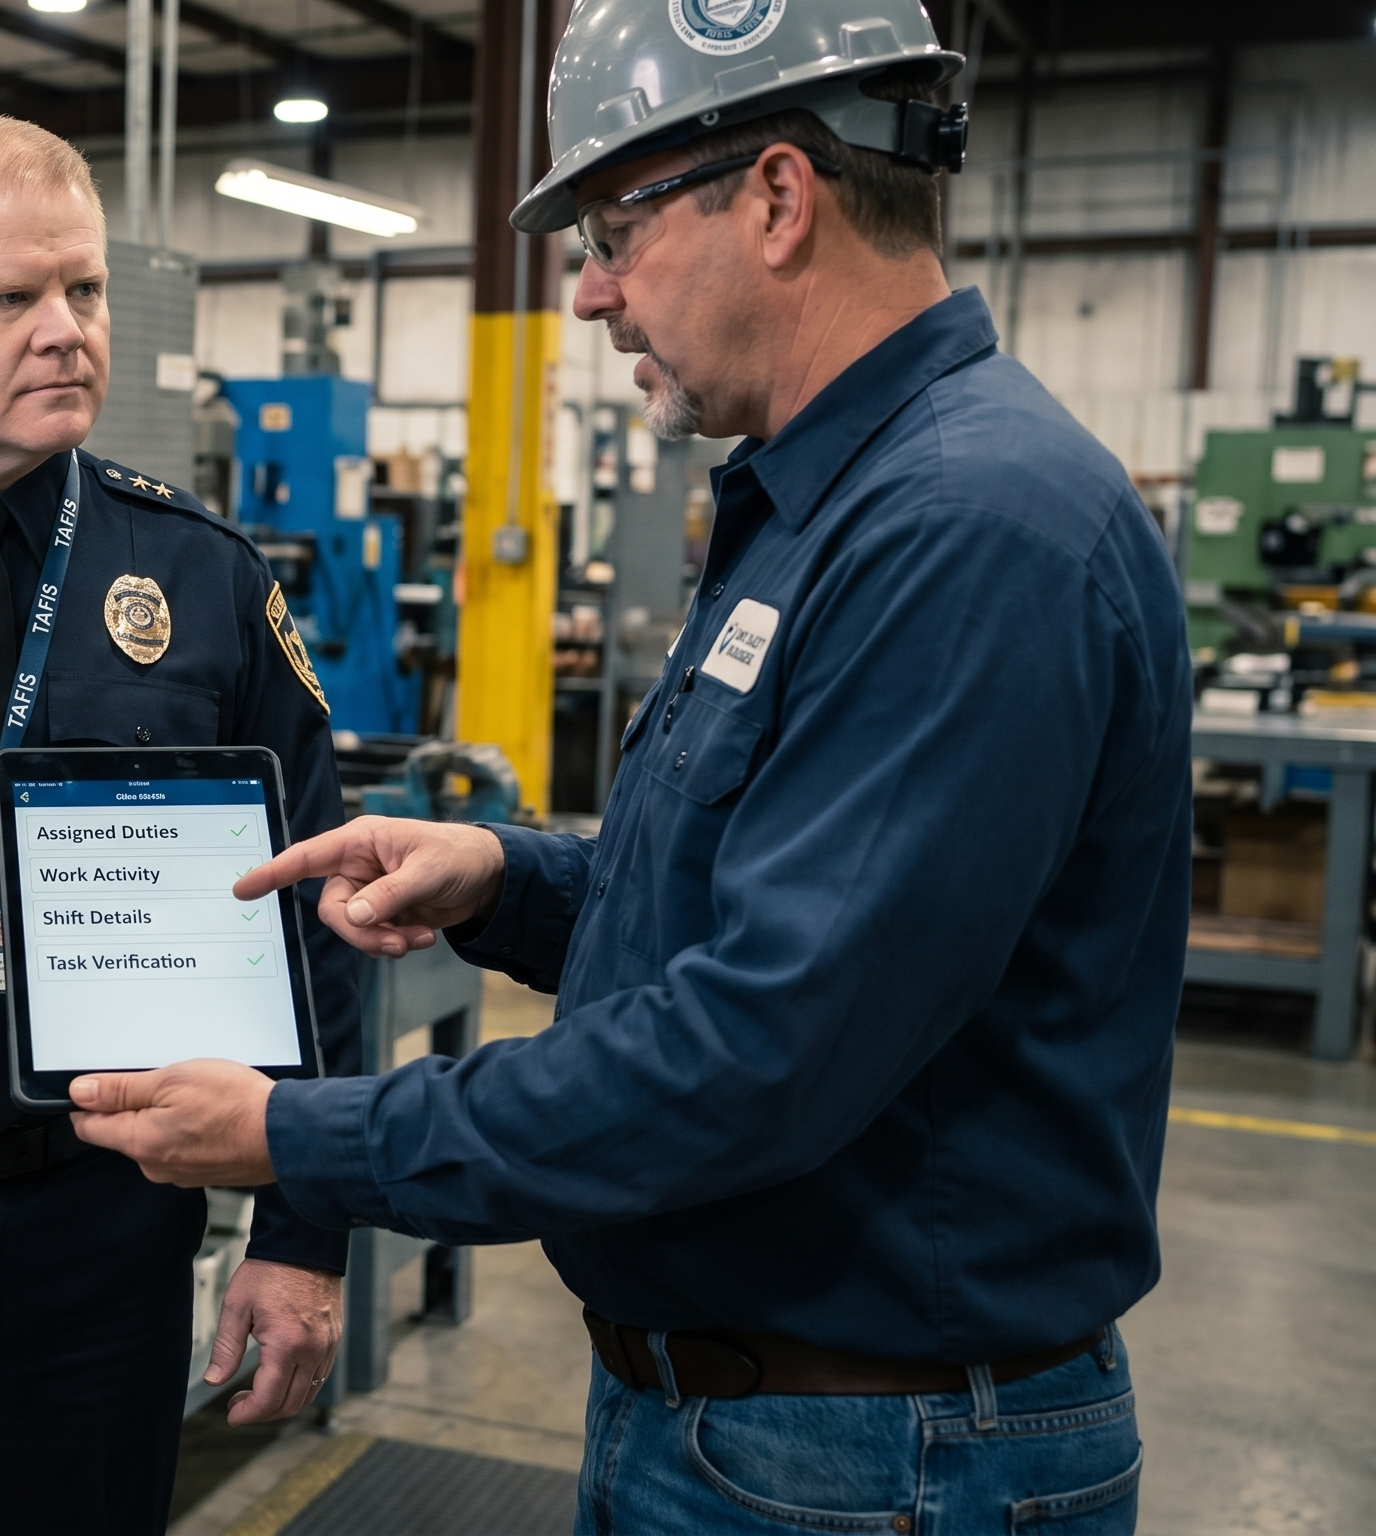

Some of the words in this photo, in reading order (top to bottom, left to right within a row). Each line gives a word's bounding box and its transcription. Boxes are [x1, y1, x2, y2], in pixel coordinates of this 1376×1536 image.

[55, 498, 77, 547] TAFIS
[32, 583, 58, 635] TAFIS
[8, 673, 36, 729] TAFIS
[36, 825, 116, 843] Assigned
[122, 825, 178, 839] Duties
[39, 867, 88, 882] Work
[93, 867, 160, 884] Activity
[43, 910, 84, 925] Shift
[90, 909, 152, 925] Details
[47, 955, 87, 970] Task
[92, 954, 196, 969] Verification
